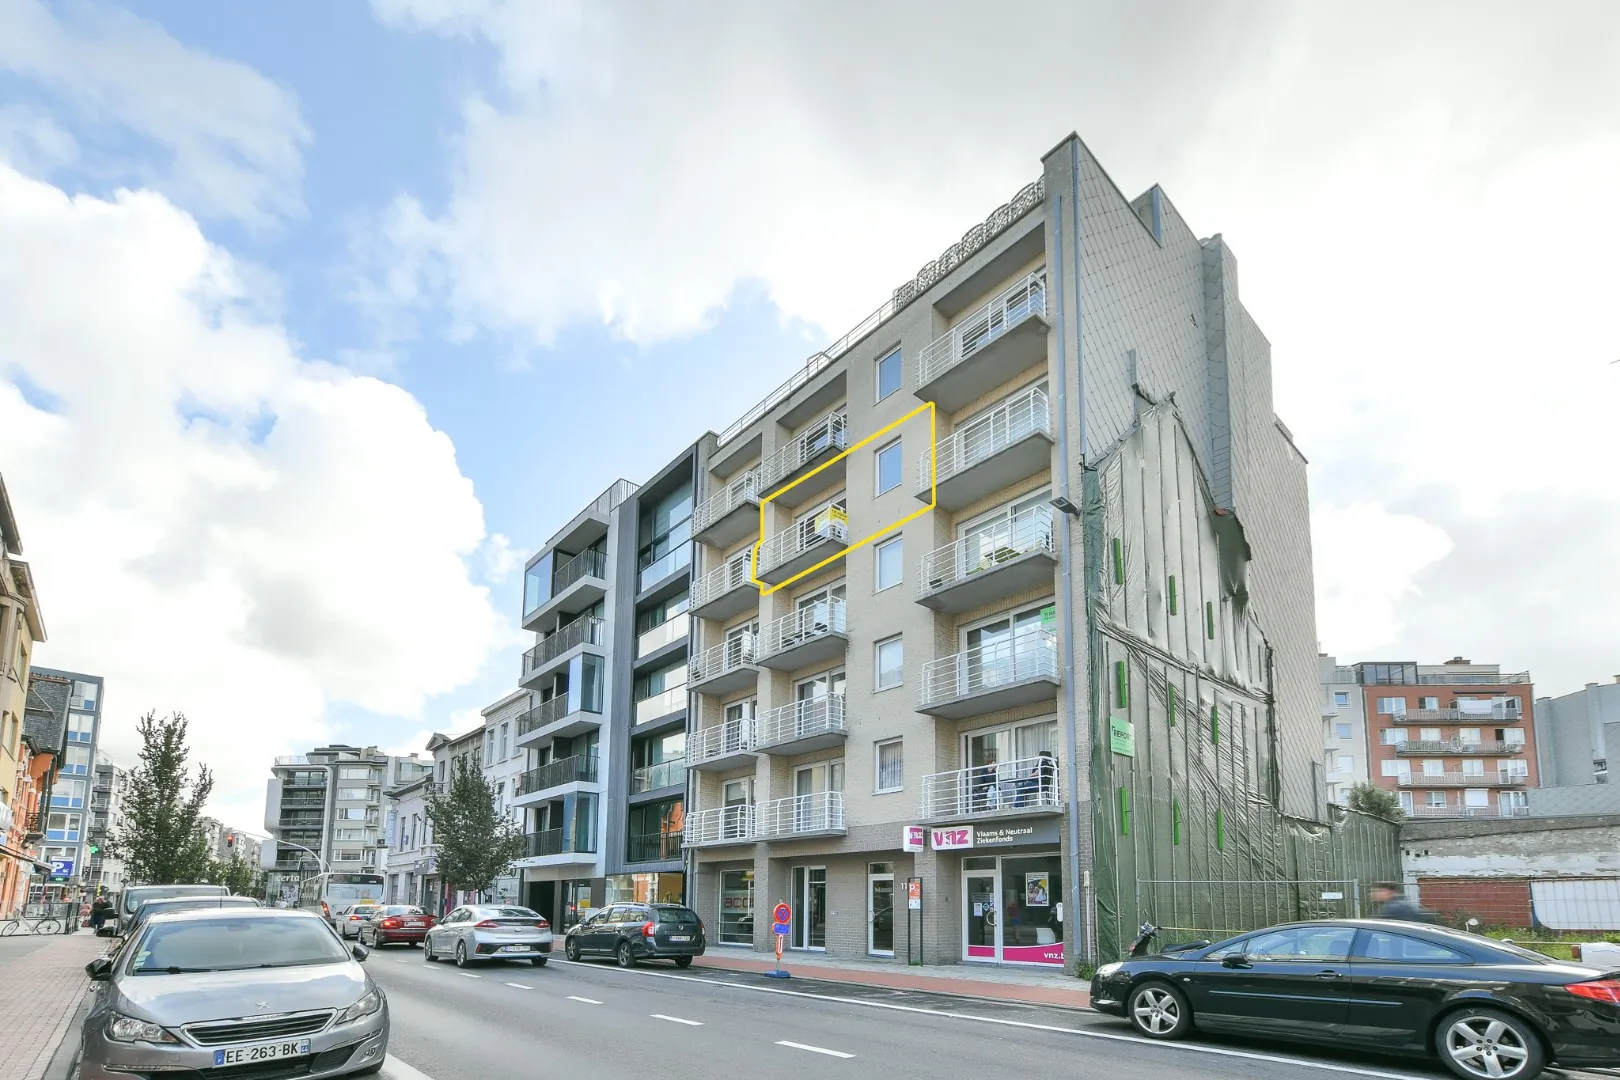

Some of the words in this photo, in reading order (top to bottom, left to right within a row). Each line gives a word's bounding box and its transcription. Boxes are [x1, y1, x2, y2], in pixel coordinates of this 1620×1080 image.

[1006, 827, 1033, 835] Neutraal
[934, 830, 968, 846] vnz
[977, 836, 1013, 844] Ziekenfonds
